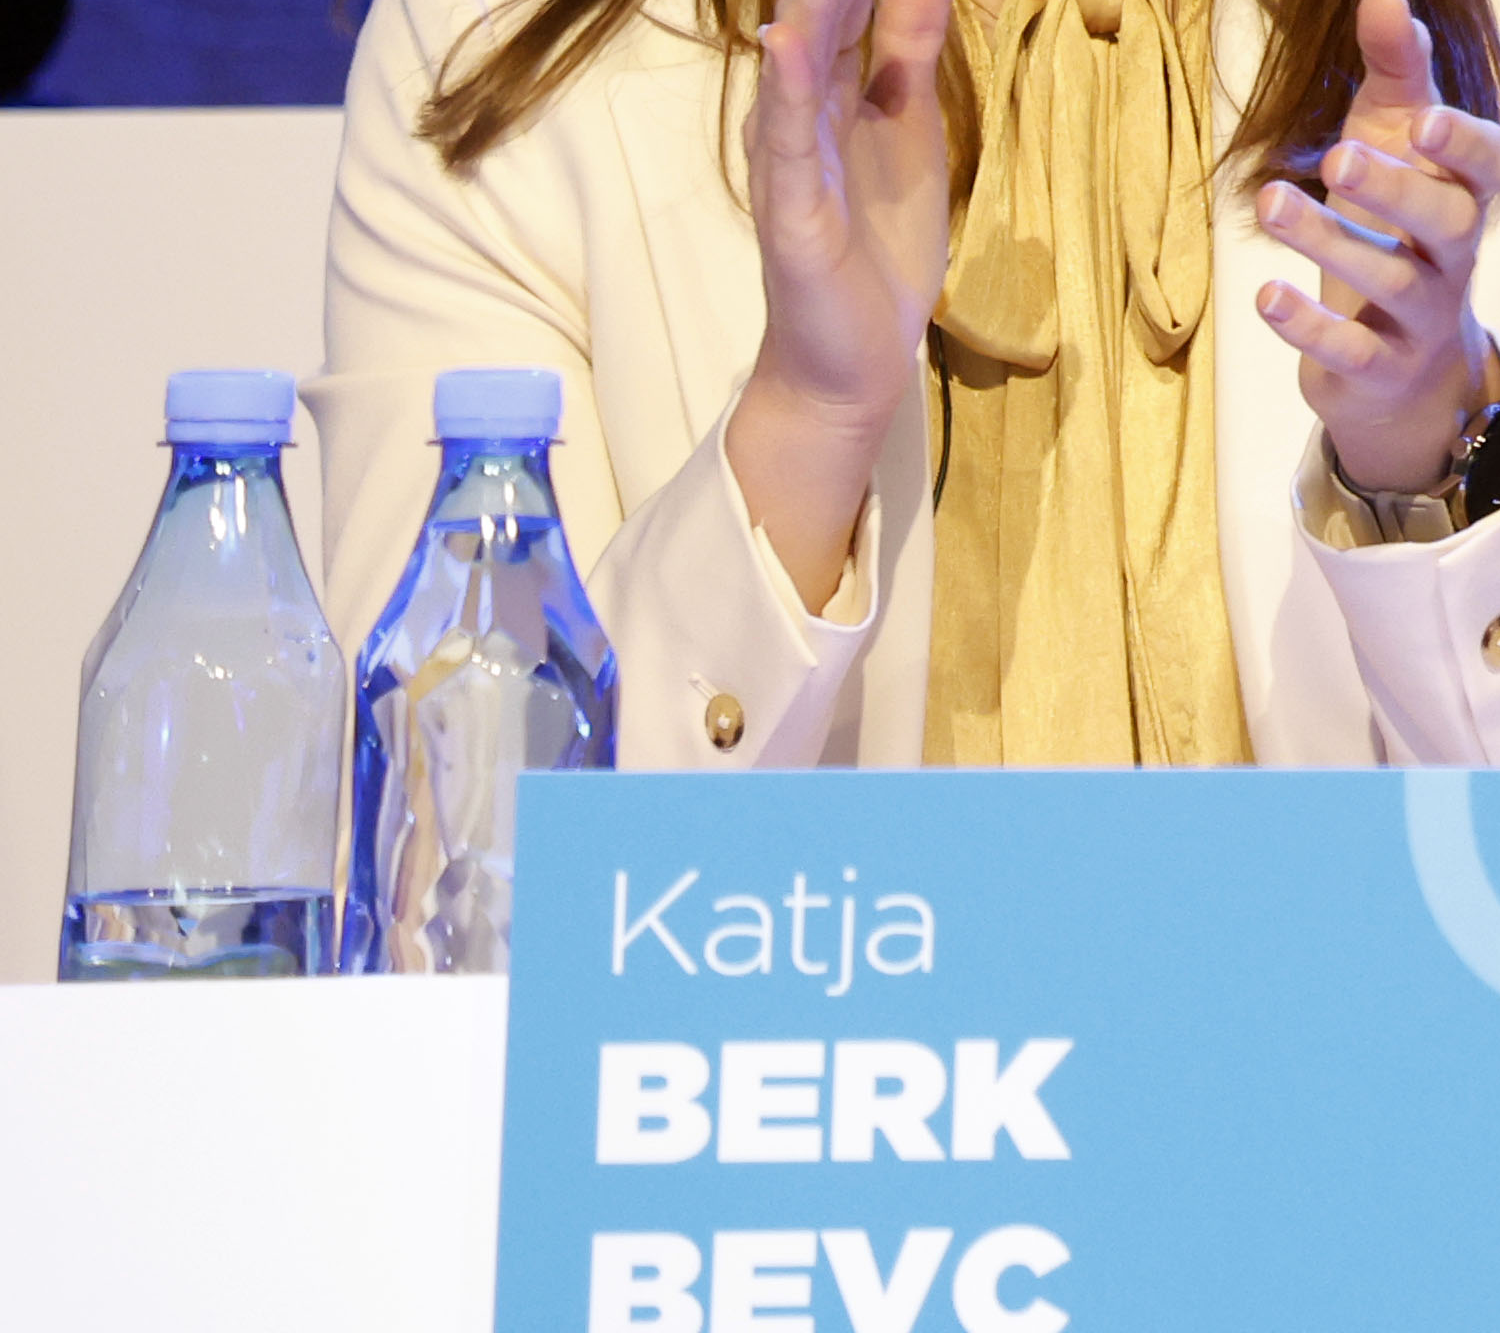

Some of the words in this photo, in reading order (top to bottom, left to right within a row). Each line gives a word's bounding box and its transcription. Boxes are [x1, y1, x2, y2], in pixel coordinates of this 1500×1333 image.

[611, 865, 936, 998] Katja
[595, 1036, 1075, 1166] BERK
[587, 1223, 1072, 1333] BEVC
